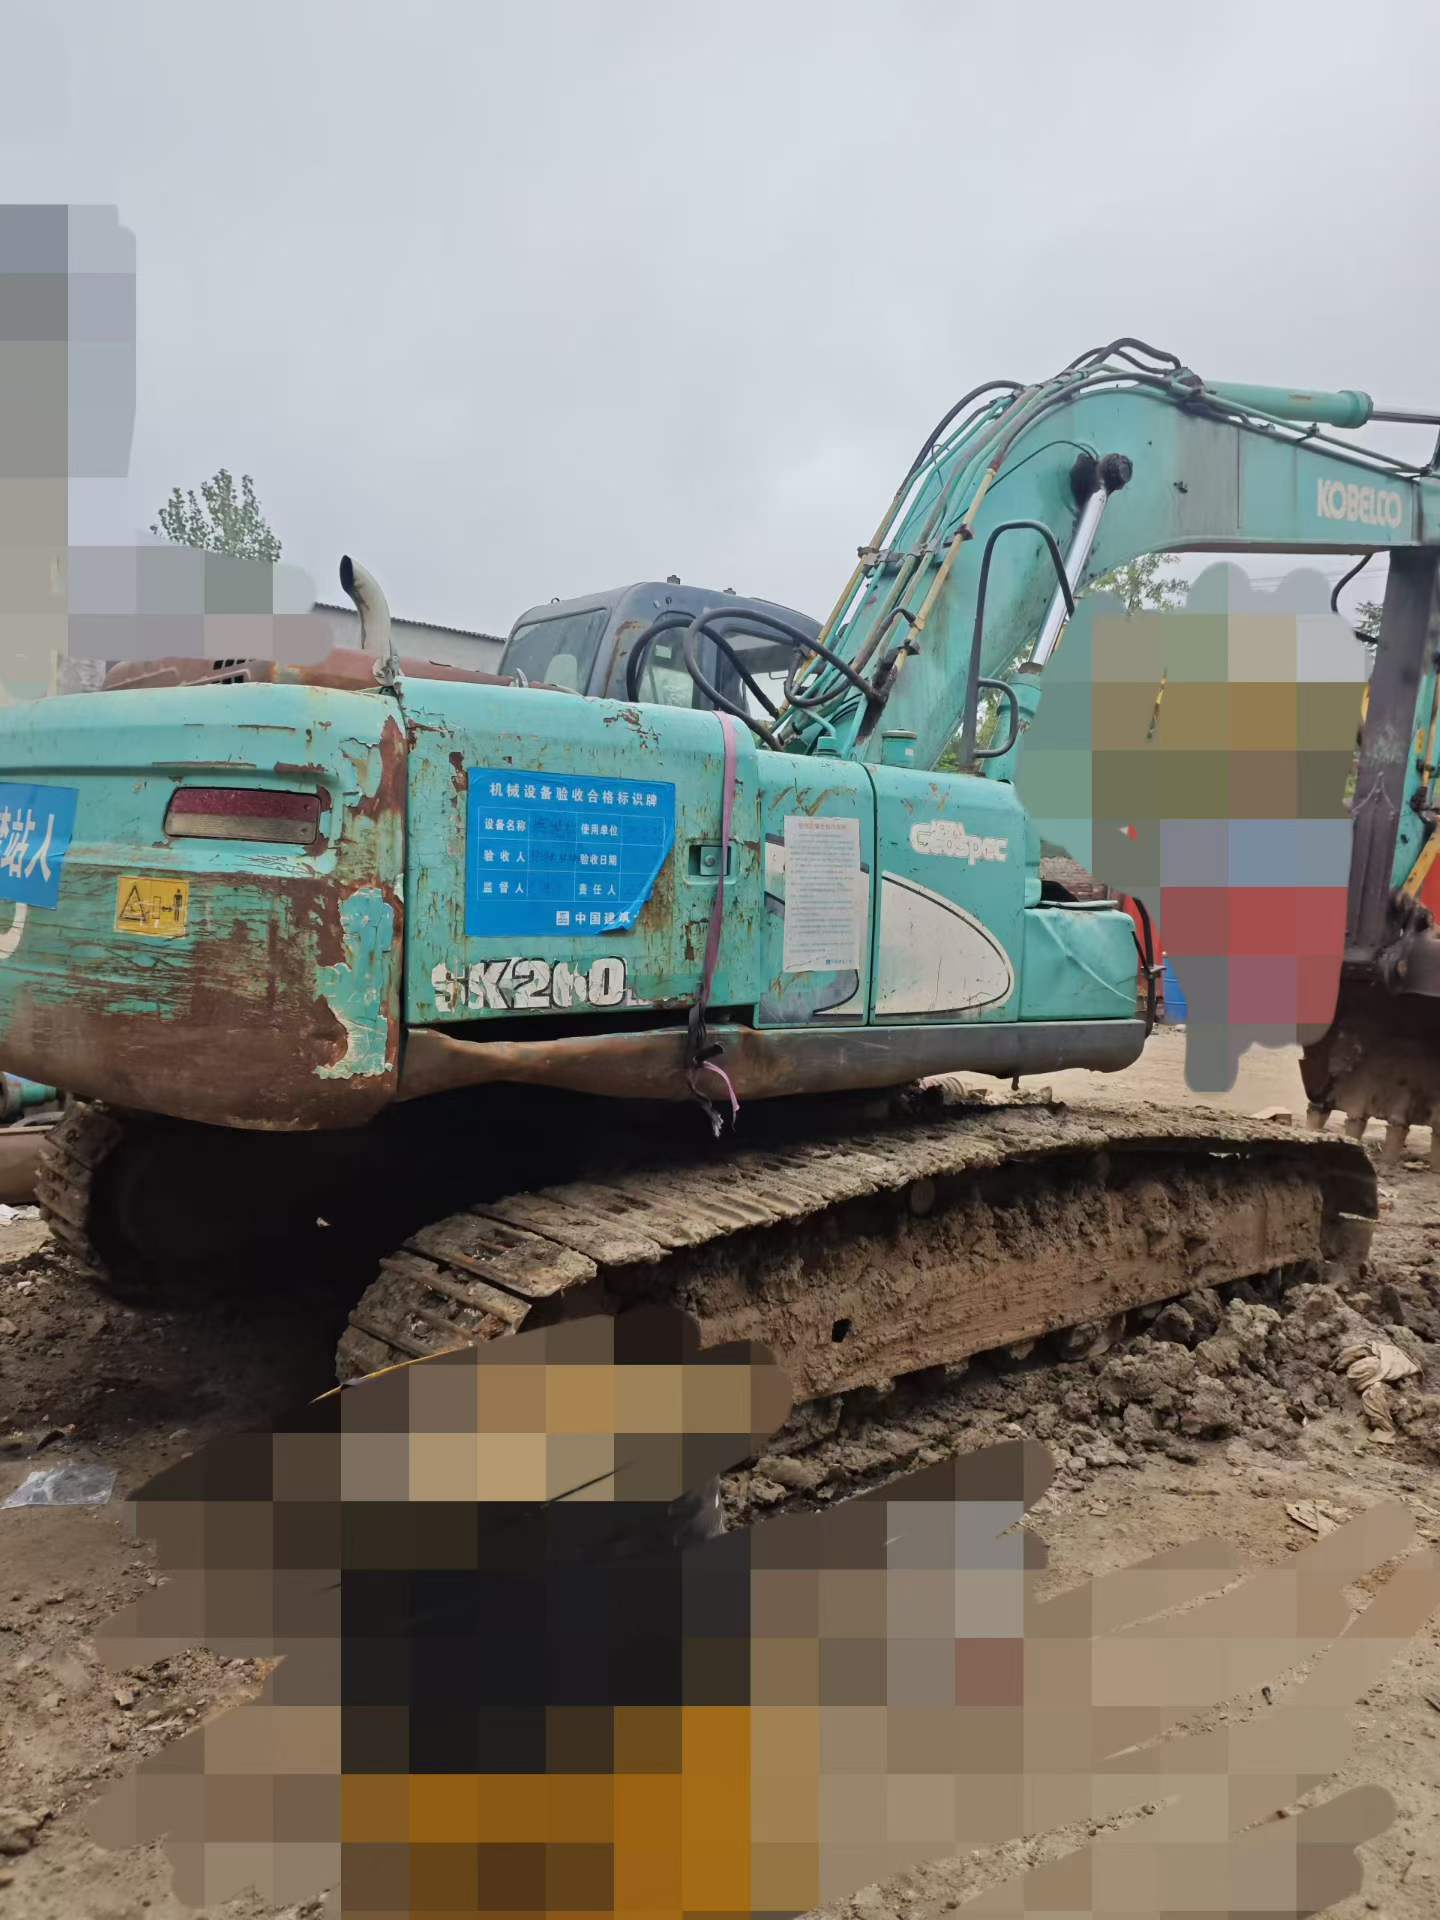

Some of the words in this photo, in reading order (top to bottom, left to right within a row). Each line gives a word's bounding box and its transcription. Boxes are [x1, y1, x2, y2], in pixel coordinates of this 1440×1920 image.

[1316, 477, 1404, 529] KOBELCO
[489, 782, 658, 807] 机械设备验收合格标识牌
[484, 817, 527, 833] 设备名称
[580, 822, 619, 837] 使用单位
[483, 849, 526, 863] 验收人
[580, 853, 618, 866] 验收日期
[482, 881, 525, 894] 监督人
[578, 883, 617, 896] 责任人
